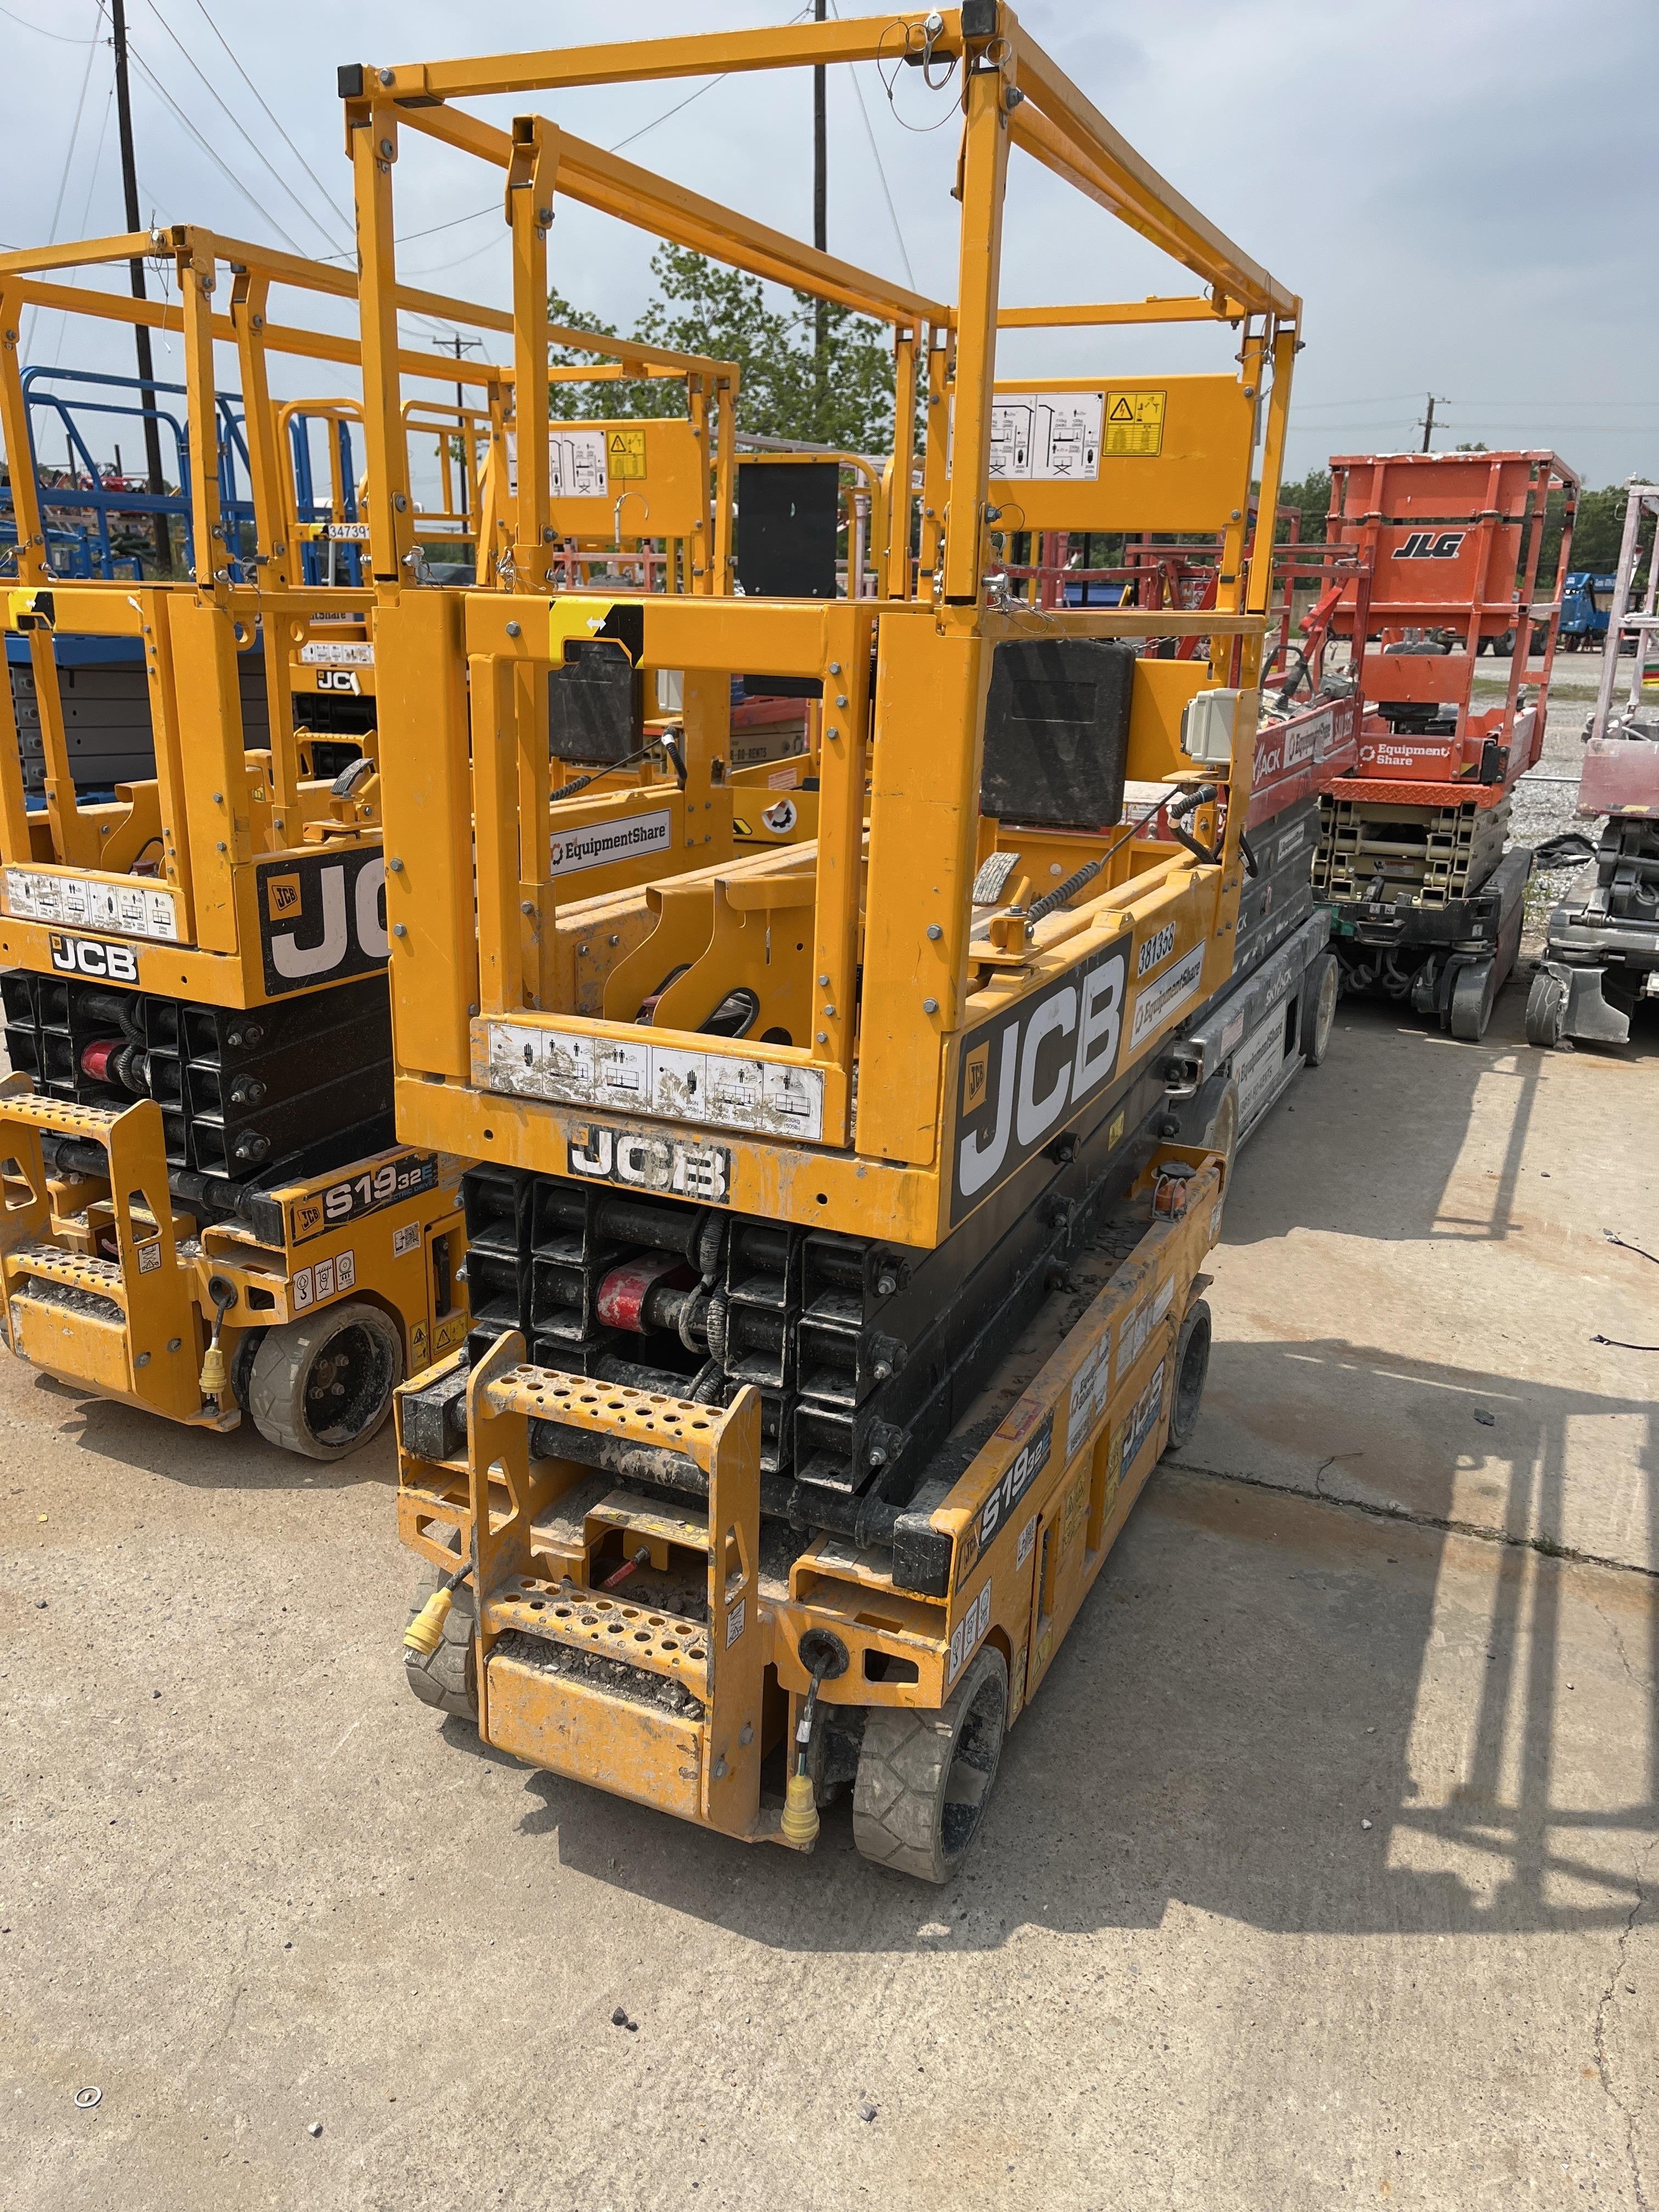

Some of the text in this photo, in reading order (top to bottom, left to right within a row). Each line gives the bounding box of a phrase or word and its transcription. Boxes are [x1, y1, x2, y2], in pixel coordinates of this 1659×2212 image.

[329, 526, 369, 538] 34739
[1392, 533, 1465, 558] JLG
[318, 672, 353, 690] JC
[1376, 755, 1413, 766] Share
[565, 825, 666, 861] EquipmentShare
[276, 885, 297, 909] JCB
[53, 938, 137, 980] JCB
[1139, 922, 1175, 975] 381358
[1143, 961, 1201, 1024] EquipmentShare
[960, 954, 1125, 1197] JCB
[969, 1063, 985, 1097] JCB
[572, 1131, 725, 1196] JCB
[301, 1208, 319, 1228] JCB
